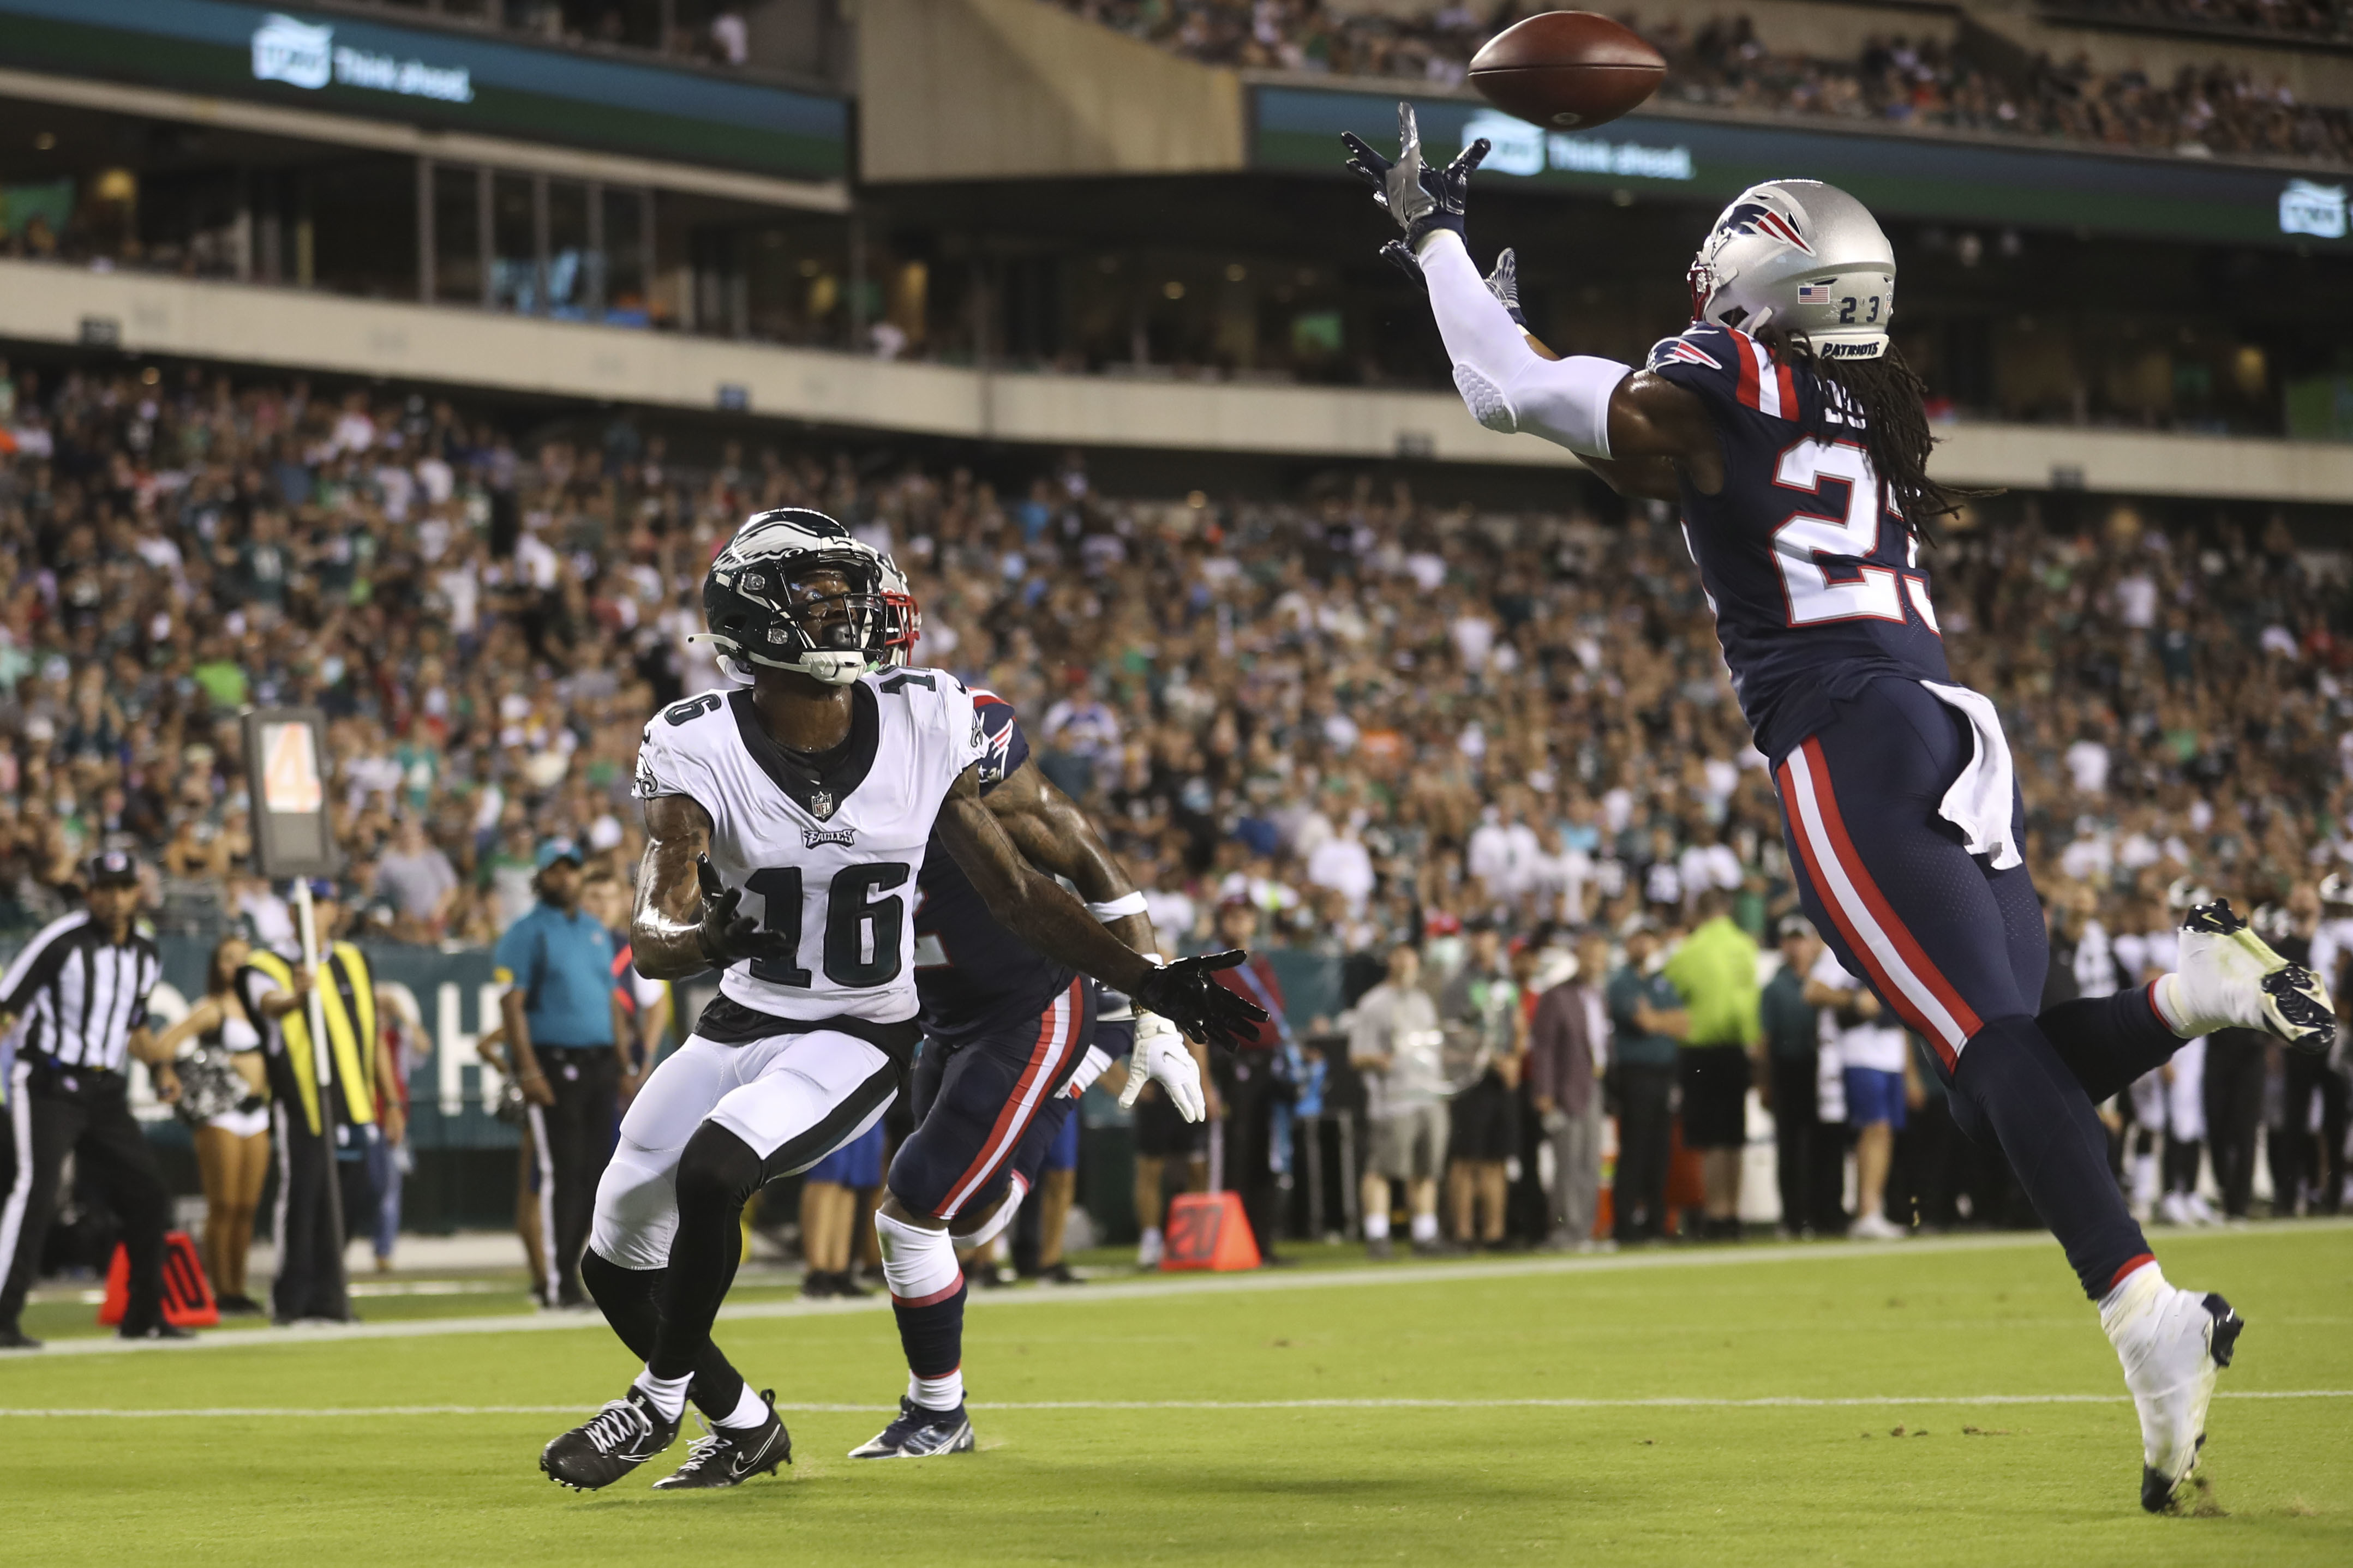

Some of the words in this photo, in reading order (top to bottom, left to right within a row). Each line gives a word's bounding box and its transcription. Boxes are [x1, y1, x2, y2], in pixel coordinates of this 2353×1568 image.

[334, 46, 396, 91] Think
[1548, 134, 1611, 174] Think
[1820, 341, 1880, 358] PATRIOTS
[264, 722, 322, 813] 4
[815, 803, 830, 815] NFL
[803, 828, 857, 850] EAGLES
[744, 862, 911, 989] 16
[1169, 1203, 1224, 1260] 20
